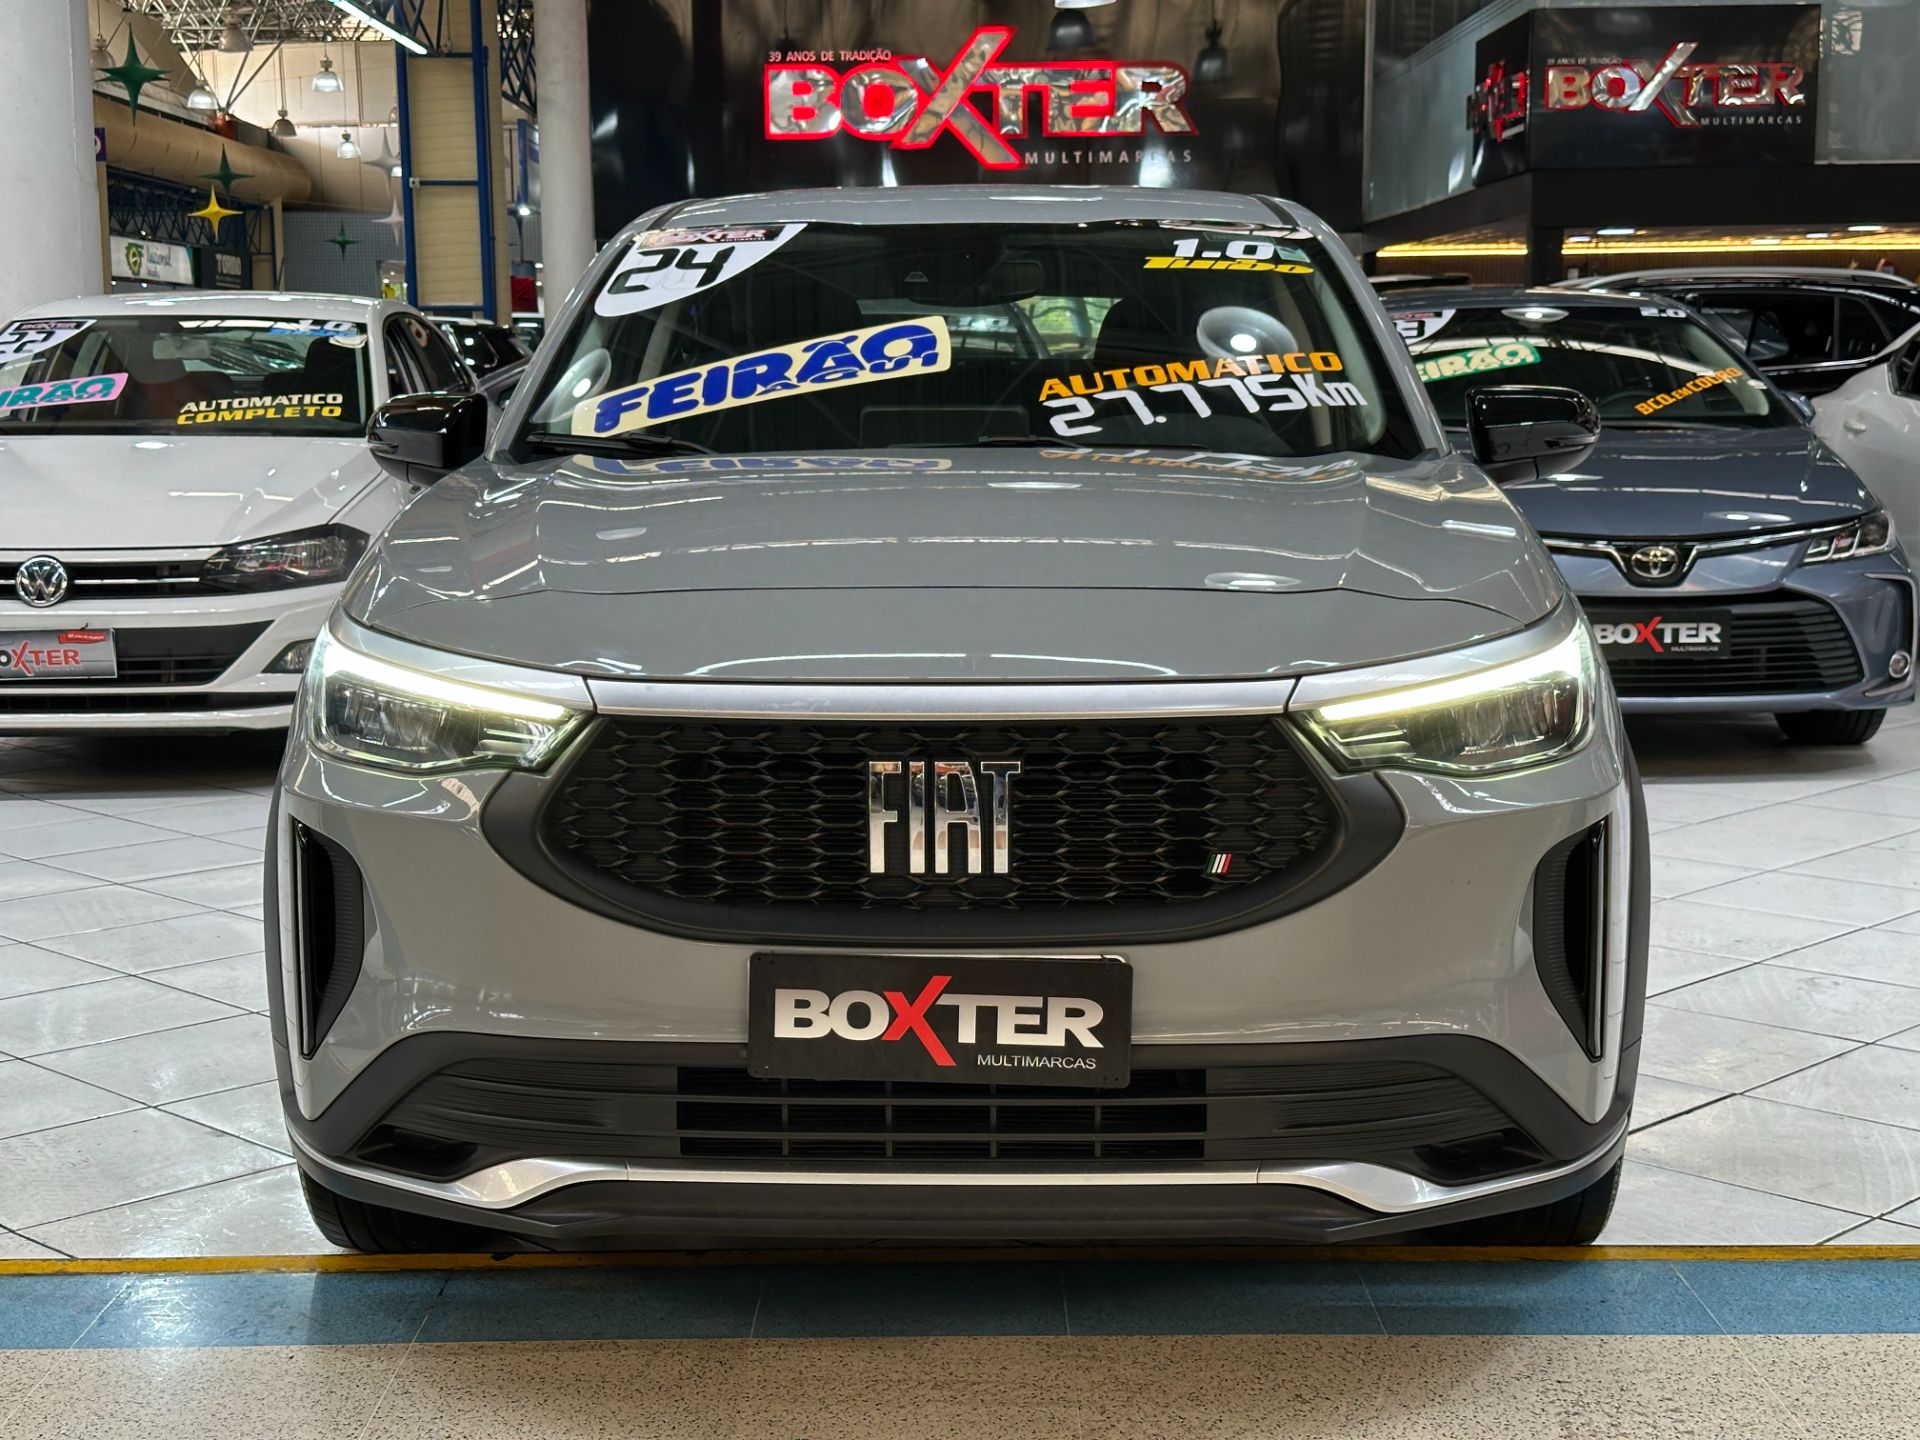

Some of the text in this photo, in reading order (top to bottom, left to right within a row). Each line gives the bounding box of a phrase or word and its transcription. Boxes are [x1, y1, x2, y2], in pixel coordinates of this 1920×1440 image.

[769, 48, 892, 63] 39 ANOS DE TRADIÇÃO
[764, 25, 1199, 170] BOXTER
[1544, 41, 1806, 128] BOXTER
[1700, 115, 1803, 127] MULTIMARCAS
[1023, 149, 1193, 166] MULTIMARCAS
[1173, 238, 1275, 260] 1.0
[606, 245, 736, 295] 24
[1143, 256, 1315, 275] Turbo
[1639, 306, 1687, 318] 2.0
[594, 324, 938, 434] FEIRÃO
[1039, 351, 1344, 402] AUTOMATICO
[1671, 386, 1693, 400] EM
[1685, 366, 1744, 393] COURO
[177, 405, 342, 425] COMPLETO
[180, 393, 344, 413] AUTOMATICO
[1592, 615, 1722, 653] BOXTER
[869, 761, 1021, 874] FIAT
[774, 975, 1105, 1068] BOXTER
[976, 1054, 1097, 1070] MULTIMARCAS
